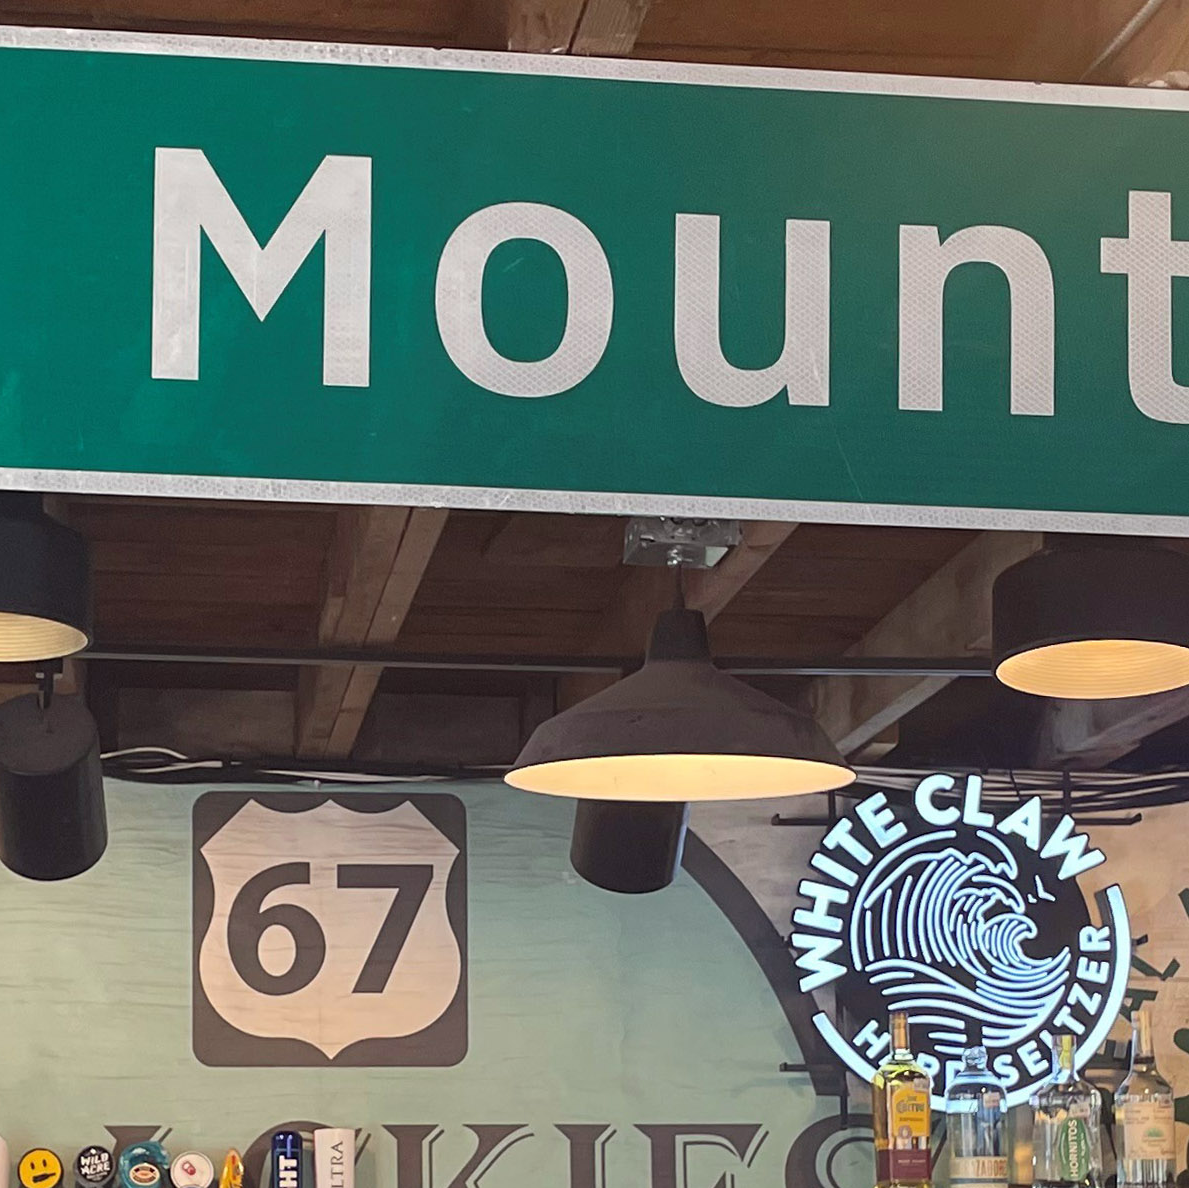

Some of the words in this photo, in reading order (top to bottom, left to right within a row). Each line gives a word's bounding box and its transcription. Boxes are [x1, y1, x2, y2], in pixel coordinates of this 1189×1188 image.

[150, 146, 1189, 425] Mount
[227, 862, 434, 996] 67
[791, 791, 908, 993] WHITE
[914, 774, 1107, 881] CLAW
[80, 1152, 109, 1166] WILD
[80, 1161, 110, 1175] ACRE
[1068, 1119, 1079, 1177] HORNITOS
